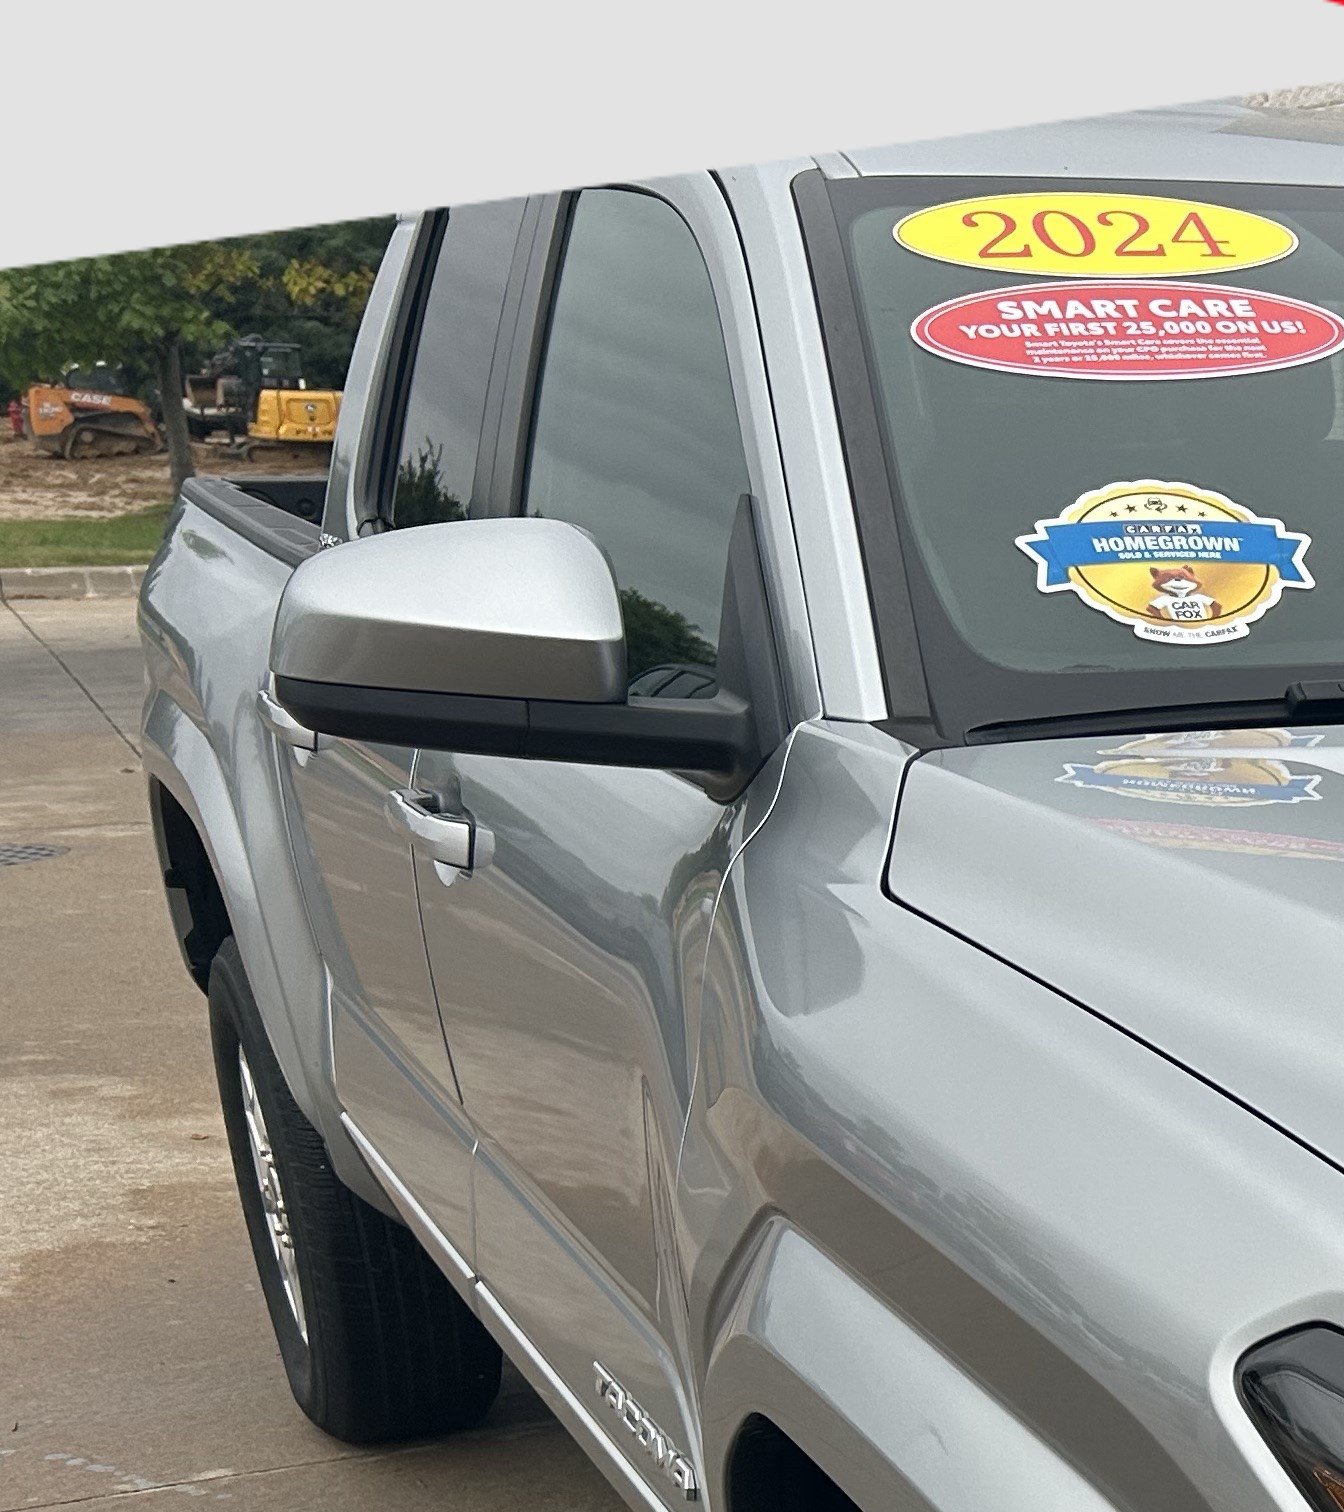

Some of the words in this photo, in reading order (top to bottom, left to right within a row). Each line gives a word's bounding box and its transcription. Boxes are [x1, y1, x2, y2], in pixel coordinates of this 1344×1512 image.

[962, 209, 1236, 259] 2024
[996, 299, 1139, 321] SMART
[1149, 299, 1257, 318] CARE
[959, 322, 1042, 339] YOUR
[1043, 321, 1117, 337] FIRST
[1122, 320, 1211, 337] 25,000
[1215, 319, 1260, 334] ON
[1262, 319, 1307, 334] US!
[70, 392, 112, 405] CASE
[1122, 524, 1202, 534] CARFAX
[1091, 535, 1240, 552] HOMEGROWN
[1171, 601, 1200, 610] CAR
[1175, 610, 1202, 619] FOX
